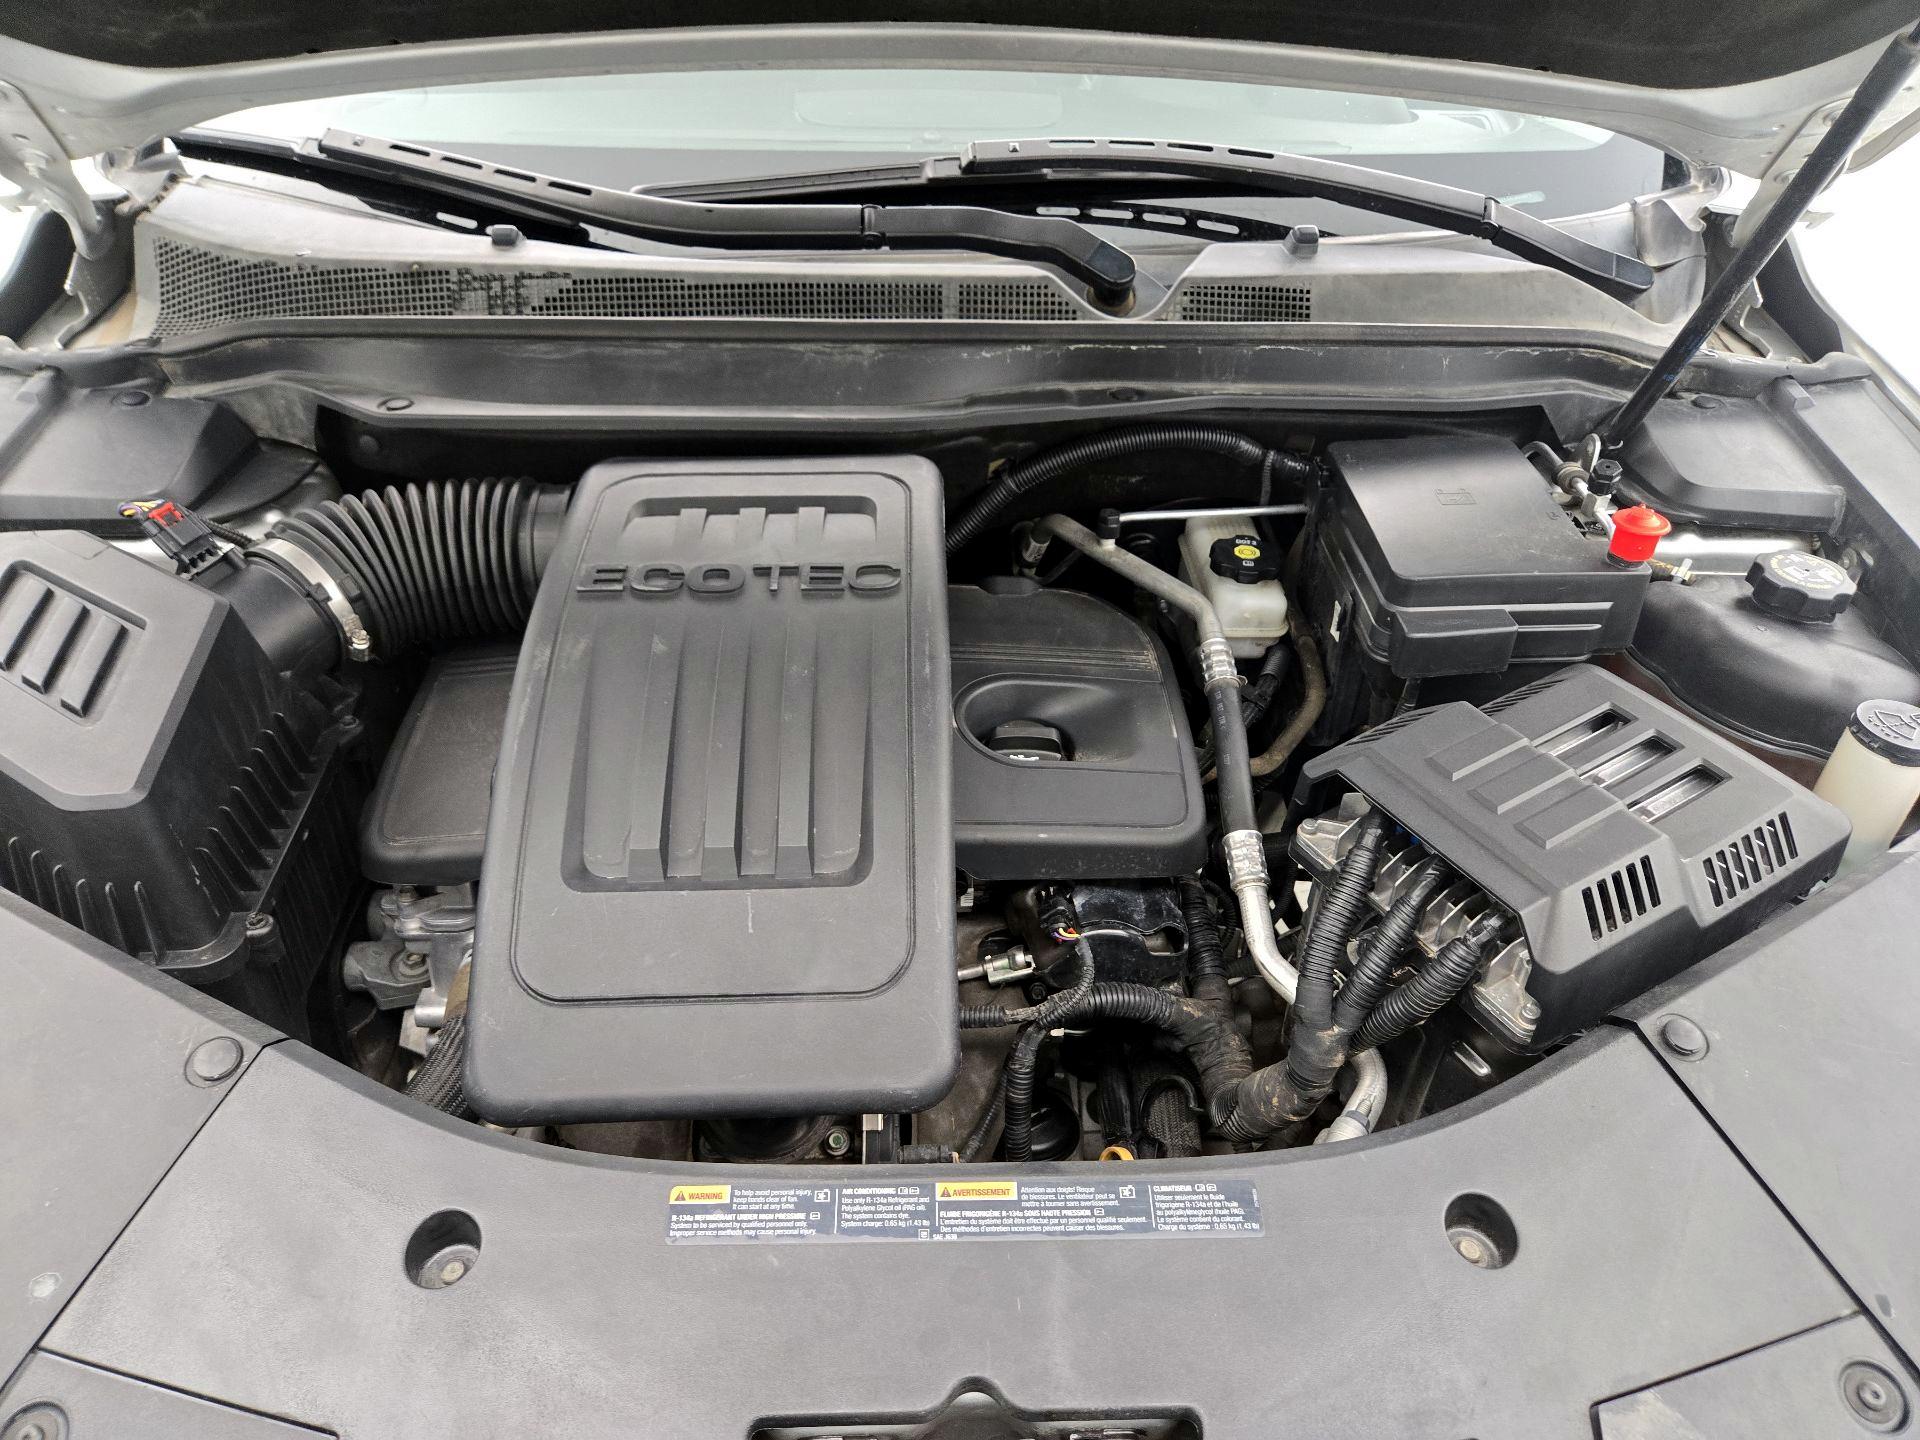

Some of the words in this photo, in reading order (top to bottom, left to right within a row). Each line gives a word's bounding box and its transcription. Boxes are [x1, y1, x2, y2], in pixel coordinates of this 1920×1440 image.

[576, 562, 902, 593] ECOTEC
[688, 1192, 723, 1200] WARNING
[952, 1188, 1011, 1197] AVERTISSEMENT
[841, 1220, 862, 1228] System
[1158, 1224, 1178, 1232] Charge
